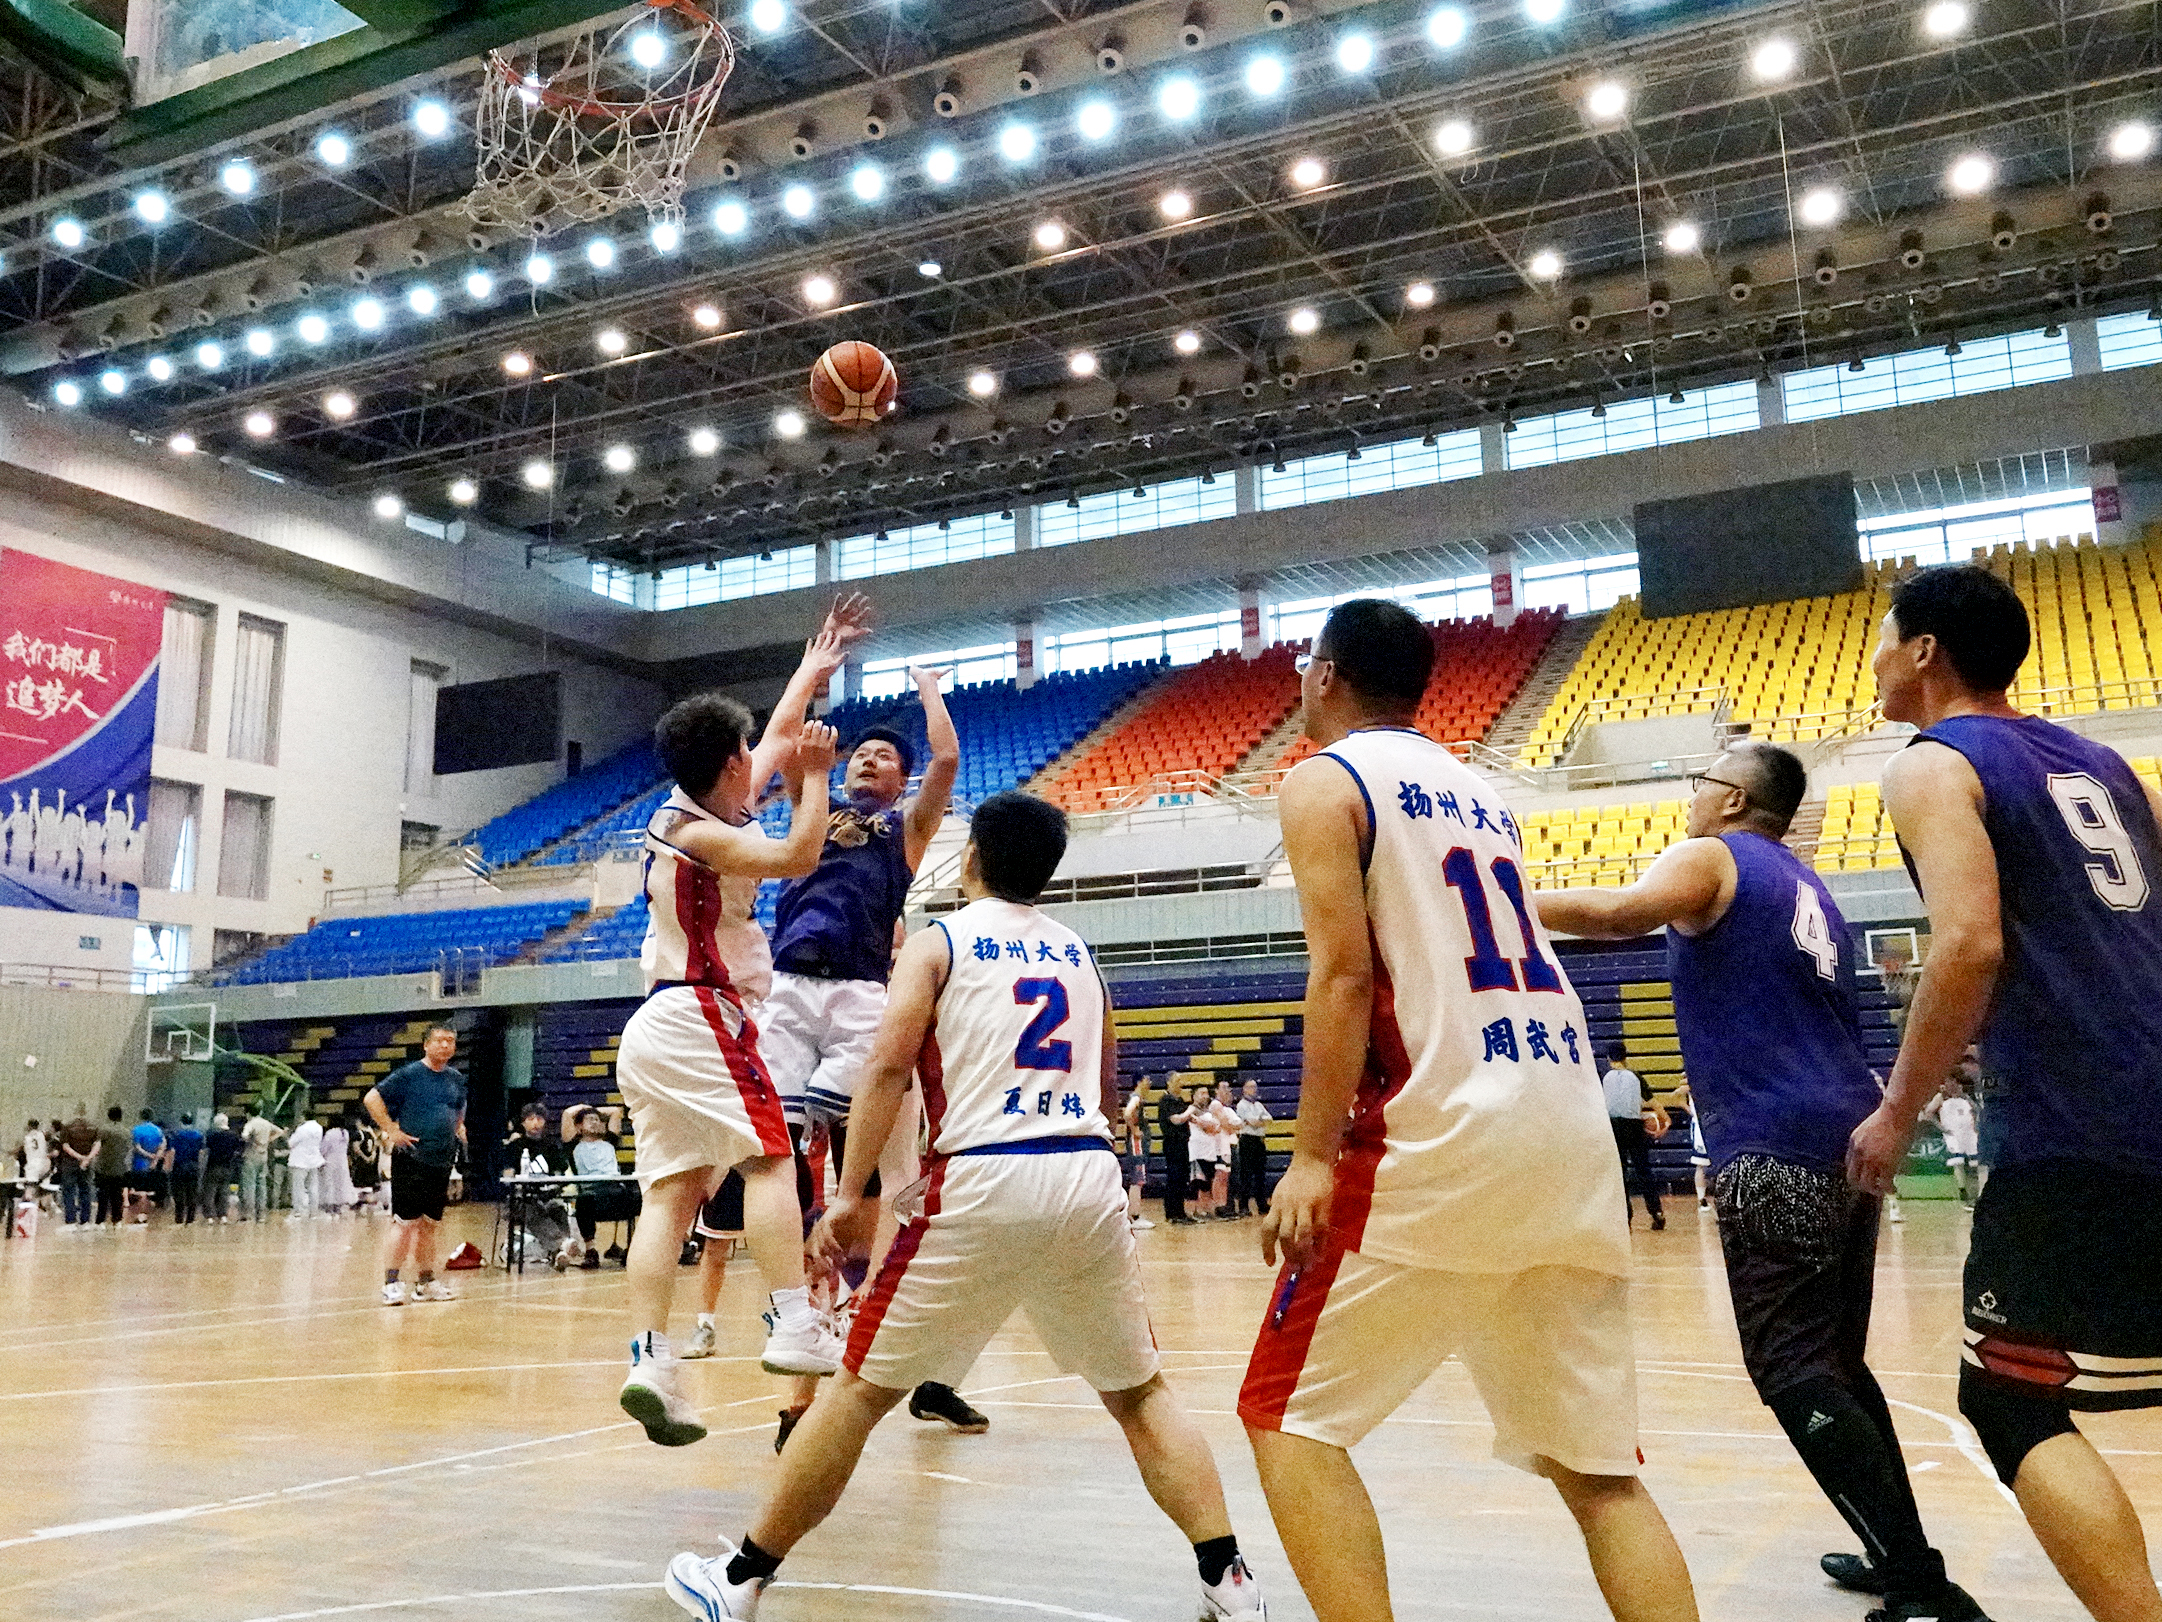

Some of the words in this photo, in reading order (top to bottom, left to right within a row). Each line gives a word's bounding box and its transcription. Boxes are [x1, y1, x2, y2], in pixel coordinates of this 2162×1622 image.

[3, 630, 108, 683] 我们都是
[6, 675, 100, 720] 追梦人
[1397, 780, 1518, 846] 扬州大学
[2047, 771, 2150, 912] 9
[972, 936, 1082, 968] 扬州大学
[1442, 846, 1565, 994] 11
[1791, 880, 1838, 981] 4
[1012, 976, 1073, 1074] 2
